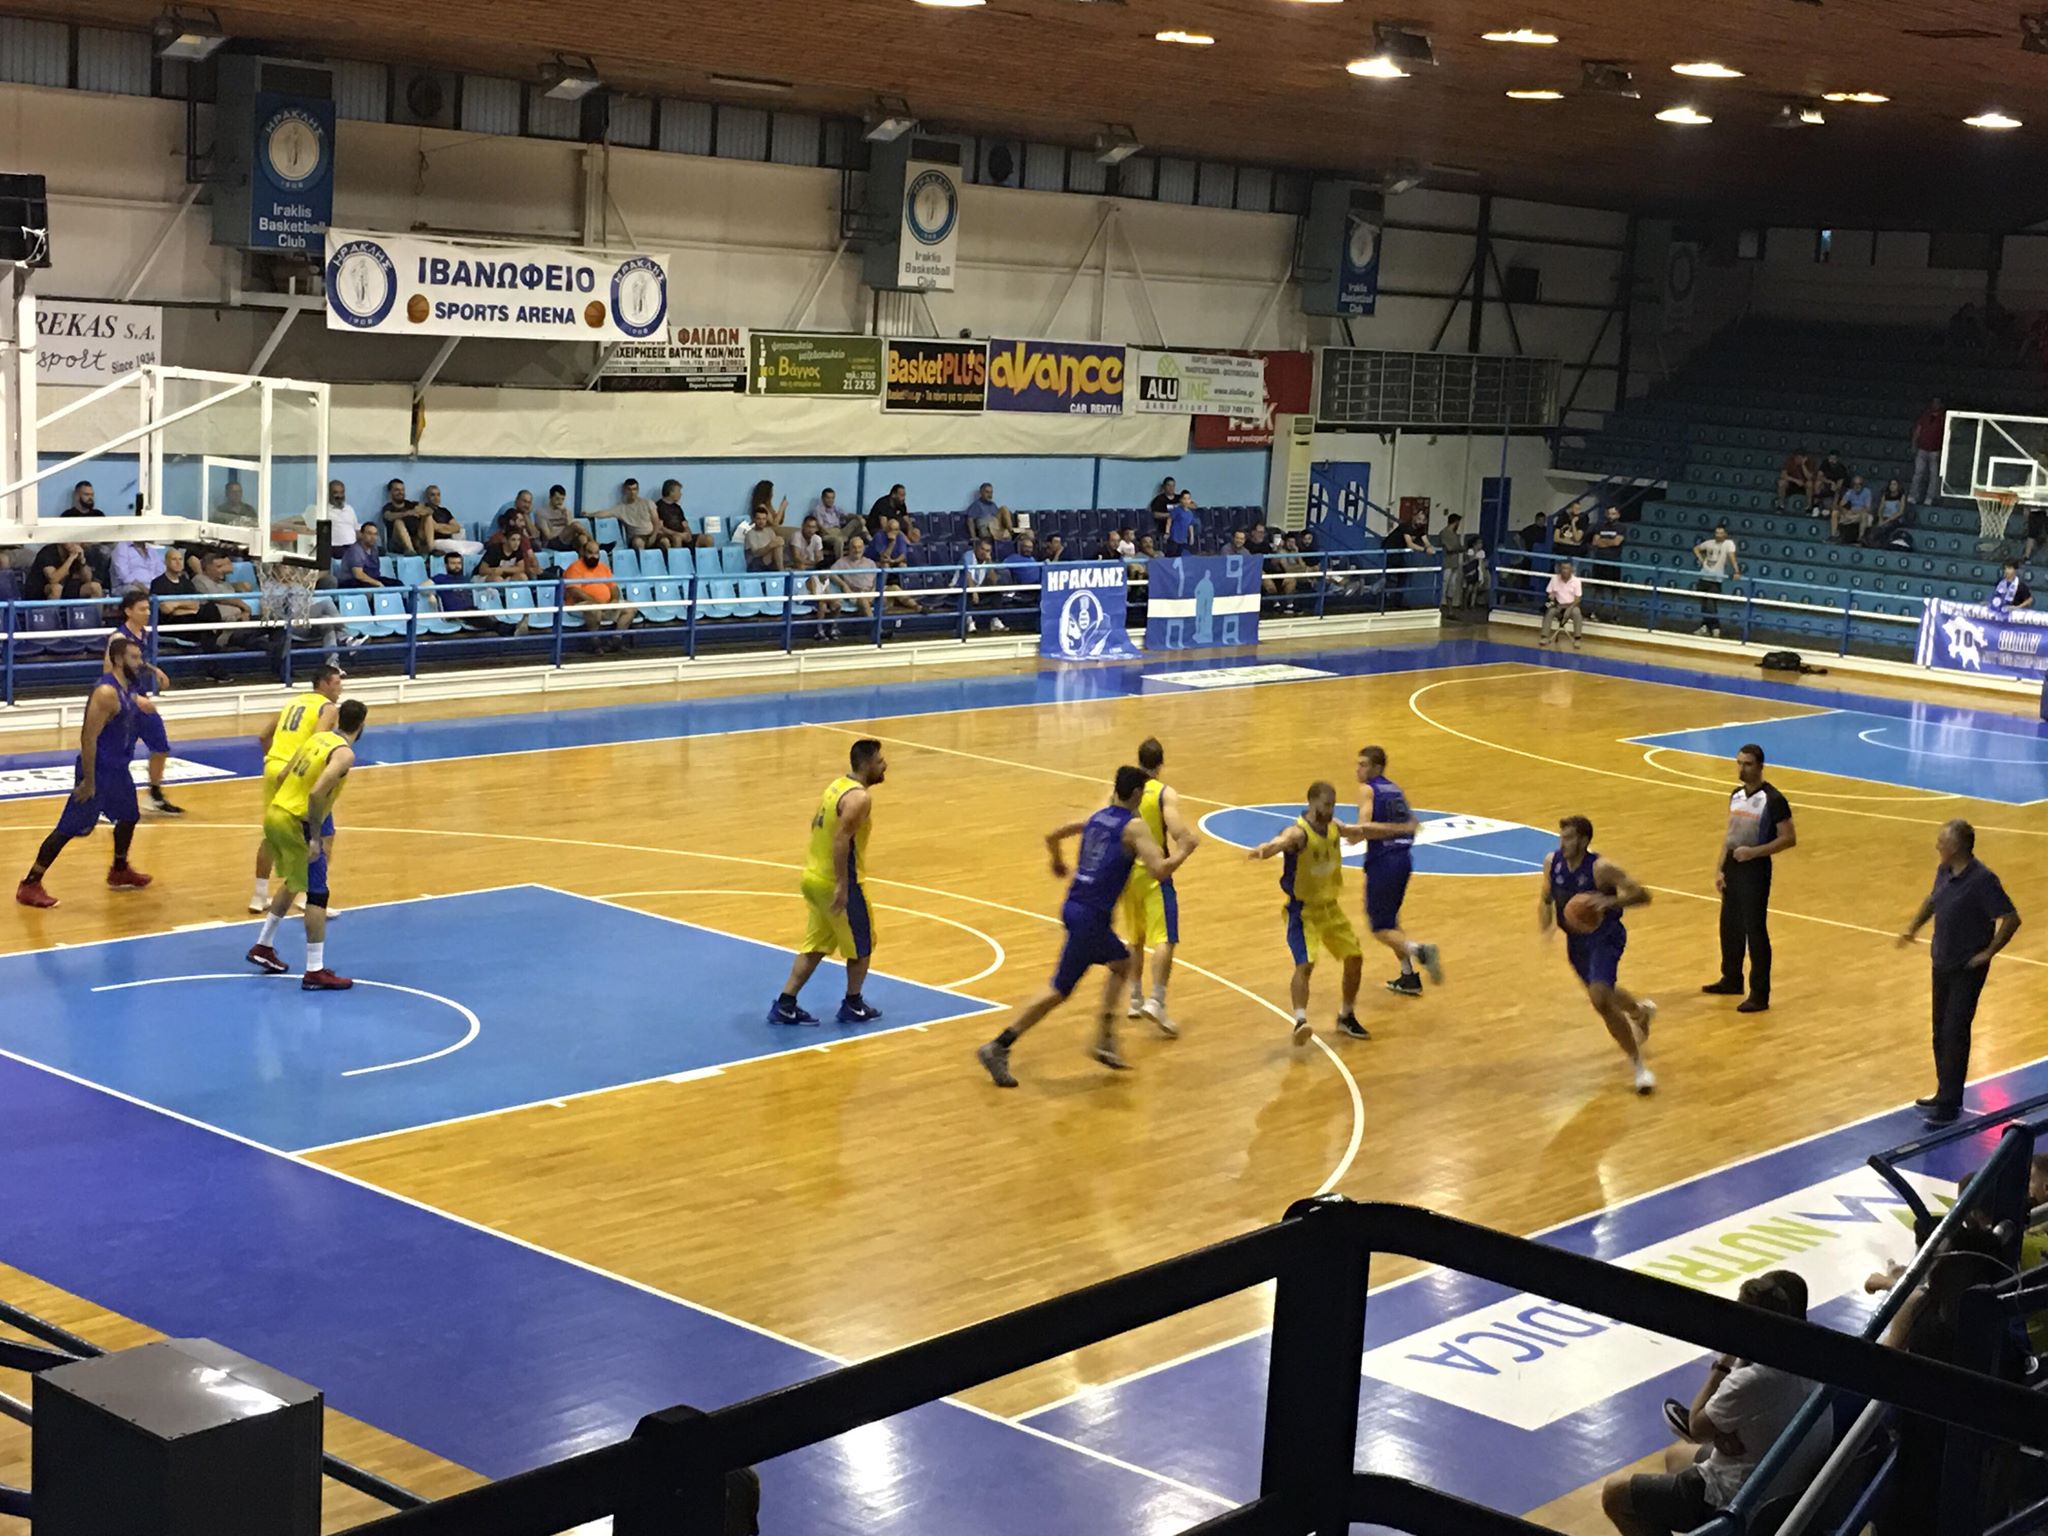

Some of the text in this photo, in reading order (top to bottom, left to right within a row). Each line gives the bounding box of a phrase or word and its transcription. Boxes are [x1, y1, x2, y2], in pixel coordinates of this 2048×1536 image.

[273, 203, 312, 218] Iraklis
[258, 217, 327, 235] Basketball
[277, 233, 306, 248] Club
[332, 243, 393, 272] ΗΡΑΚΛΗΣ
[418, 256, 595, 293] ΙΒΑΝΩΦΕΙΟ
[614, 259, 664, 283] ΗΡΑΚΛΗΣ
[905, 262, 951, 276] Basketball
[435, 301, 576, 325] SPORTS ARENA
[124, 323, 155, 340] S.A.
[678, 328, 740, 345] ΦΑΙΔΩΝ
[36, 348, 107, 372] sport
[111, 360, 134, 375] Since
[669, 347, 703, 358] ΒΑΤΤΗΣ
[778, 355, 821, 379] Βάγγος
[888, 349, 986, 386] BasketPLUS
[843, 380, 877, 390] 21 22 55
[1147, 379, 1177, 400] ALU
[1070, 403, 1122, 415] CAR RENTAL
[1047, 567, 1125, 592] ΗΡΑΚΛΗΣ
[1226, 555, 1244, 595] 9
[1954, 628, 1974, 648] 10
[282, 705, 306, 731] 10
